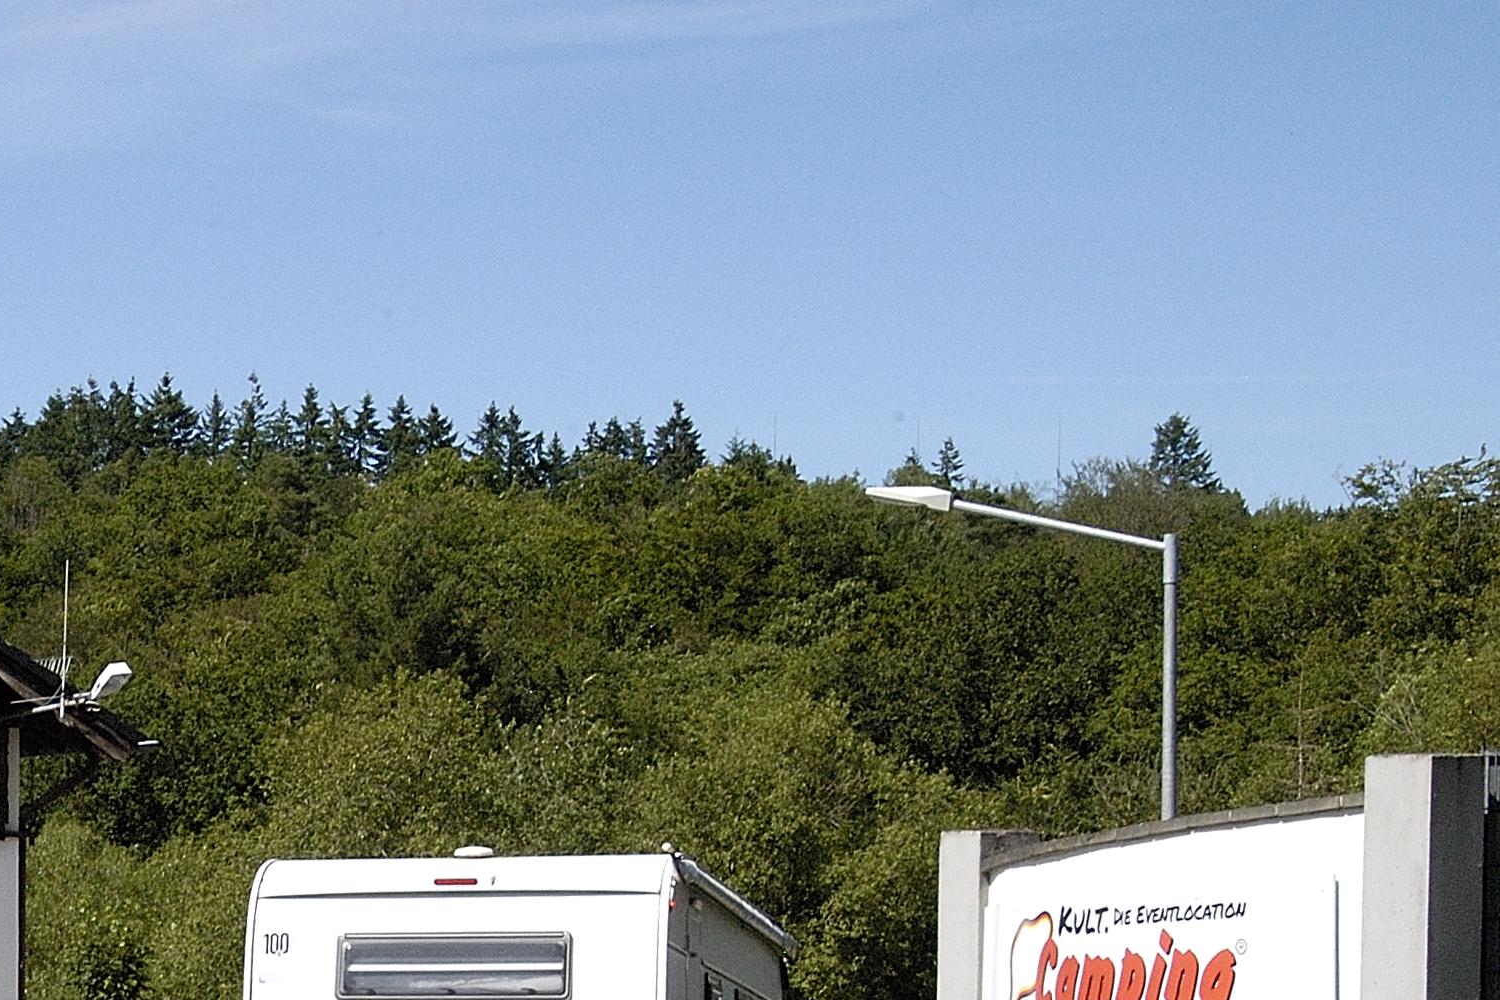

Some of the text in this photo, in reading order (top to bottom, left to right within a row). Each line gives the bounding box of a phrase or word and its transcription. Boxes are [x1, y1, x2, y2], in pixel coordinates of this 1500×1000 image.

[1058, 902, 1247, 937] KULT. DIE EVENTLOCATION
[263, 932, 290, 955] 100
